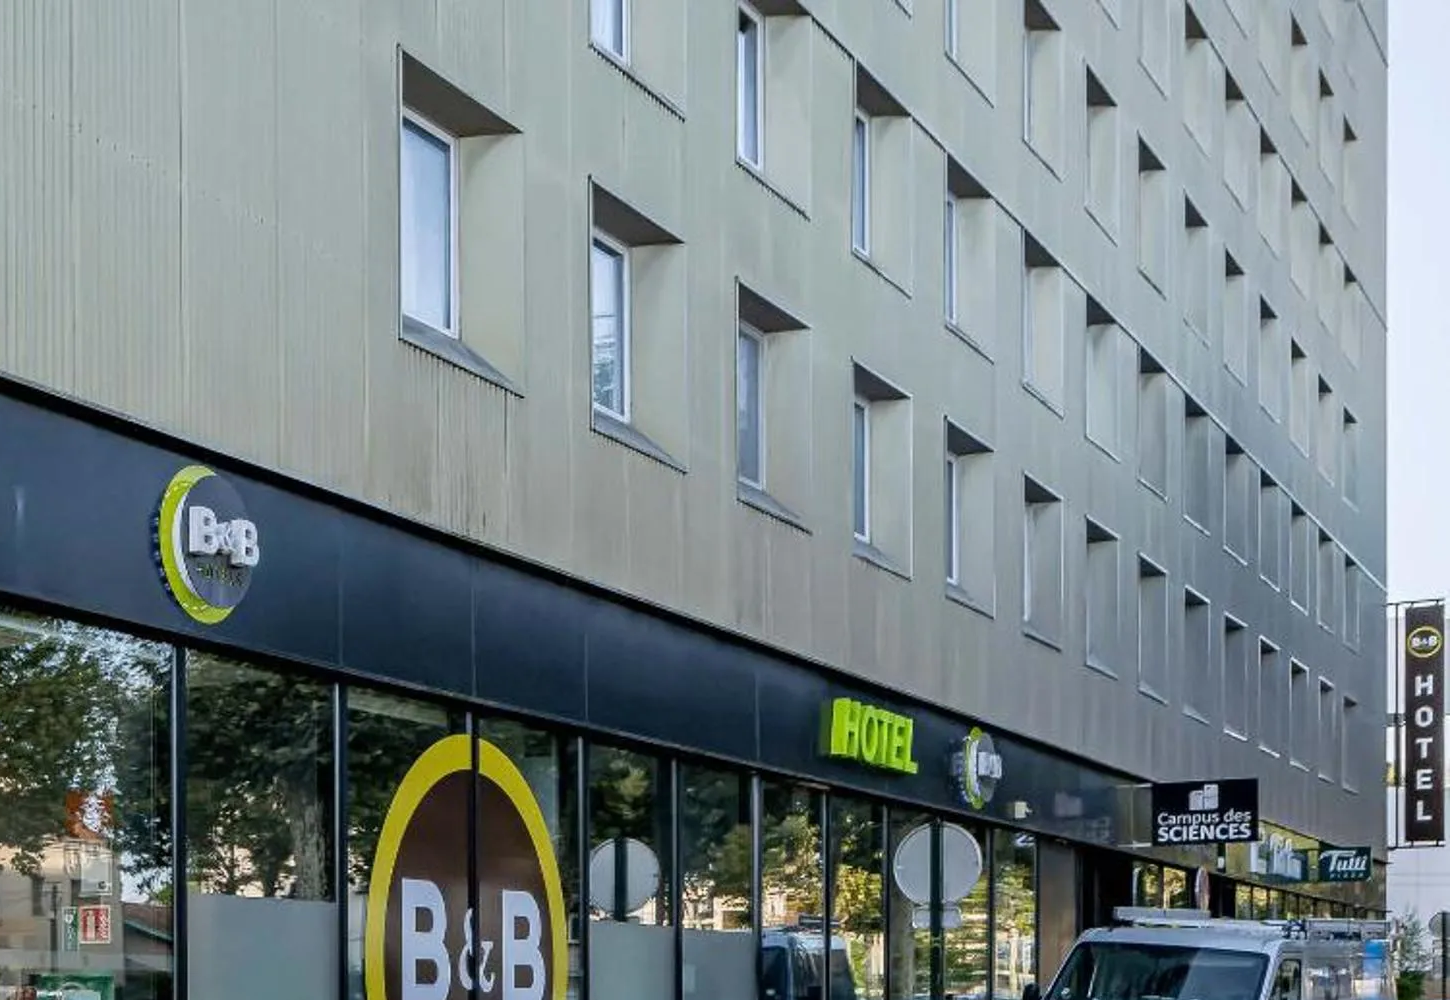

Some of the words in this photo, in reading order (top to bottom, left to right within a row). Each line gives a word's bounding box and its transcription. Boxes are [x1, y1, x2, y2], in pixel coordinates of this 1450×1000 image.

[188, 505, 260, 567] B&B
[1411, 633, 1438, 648] B&B
[830, 697, 918, 775] HOTEL
[1414, 674, 1435, 822] HOTEL
[1157, 811, 1220, 827] Campus
[1223, 807, 1253, 823] des
[1157, 823, 1252, 842] SCIENCES
